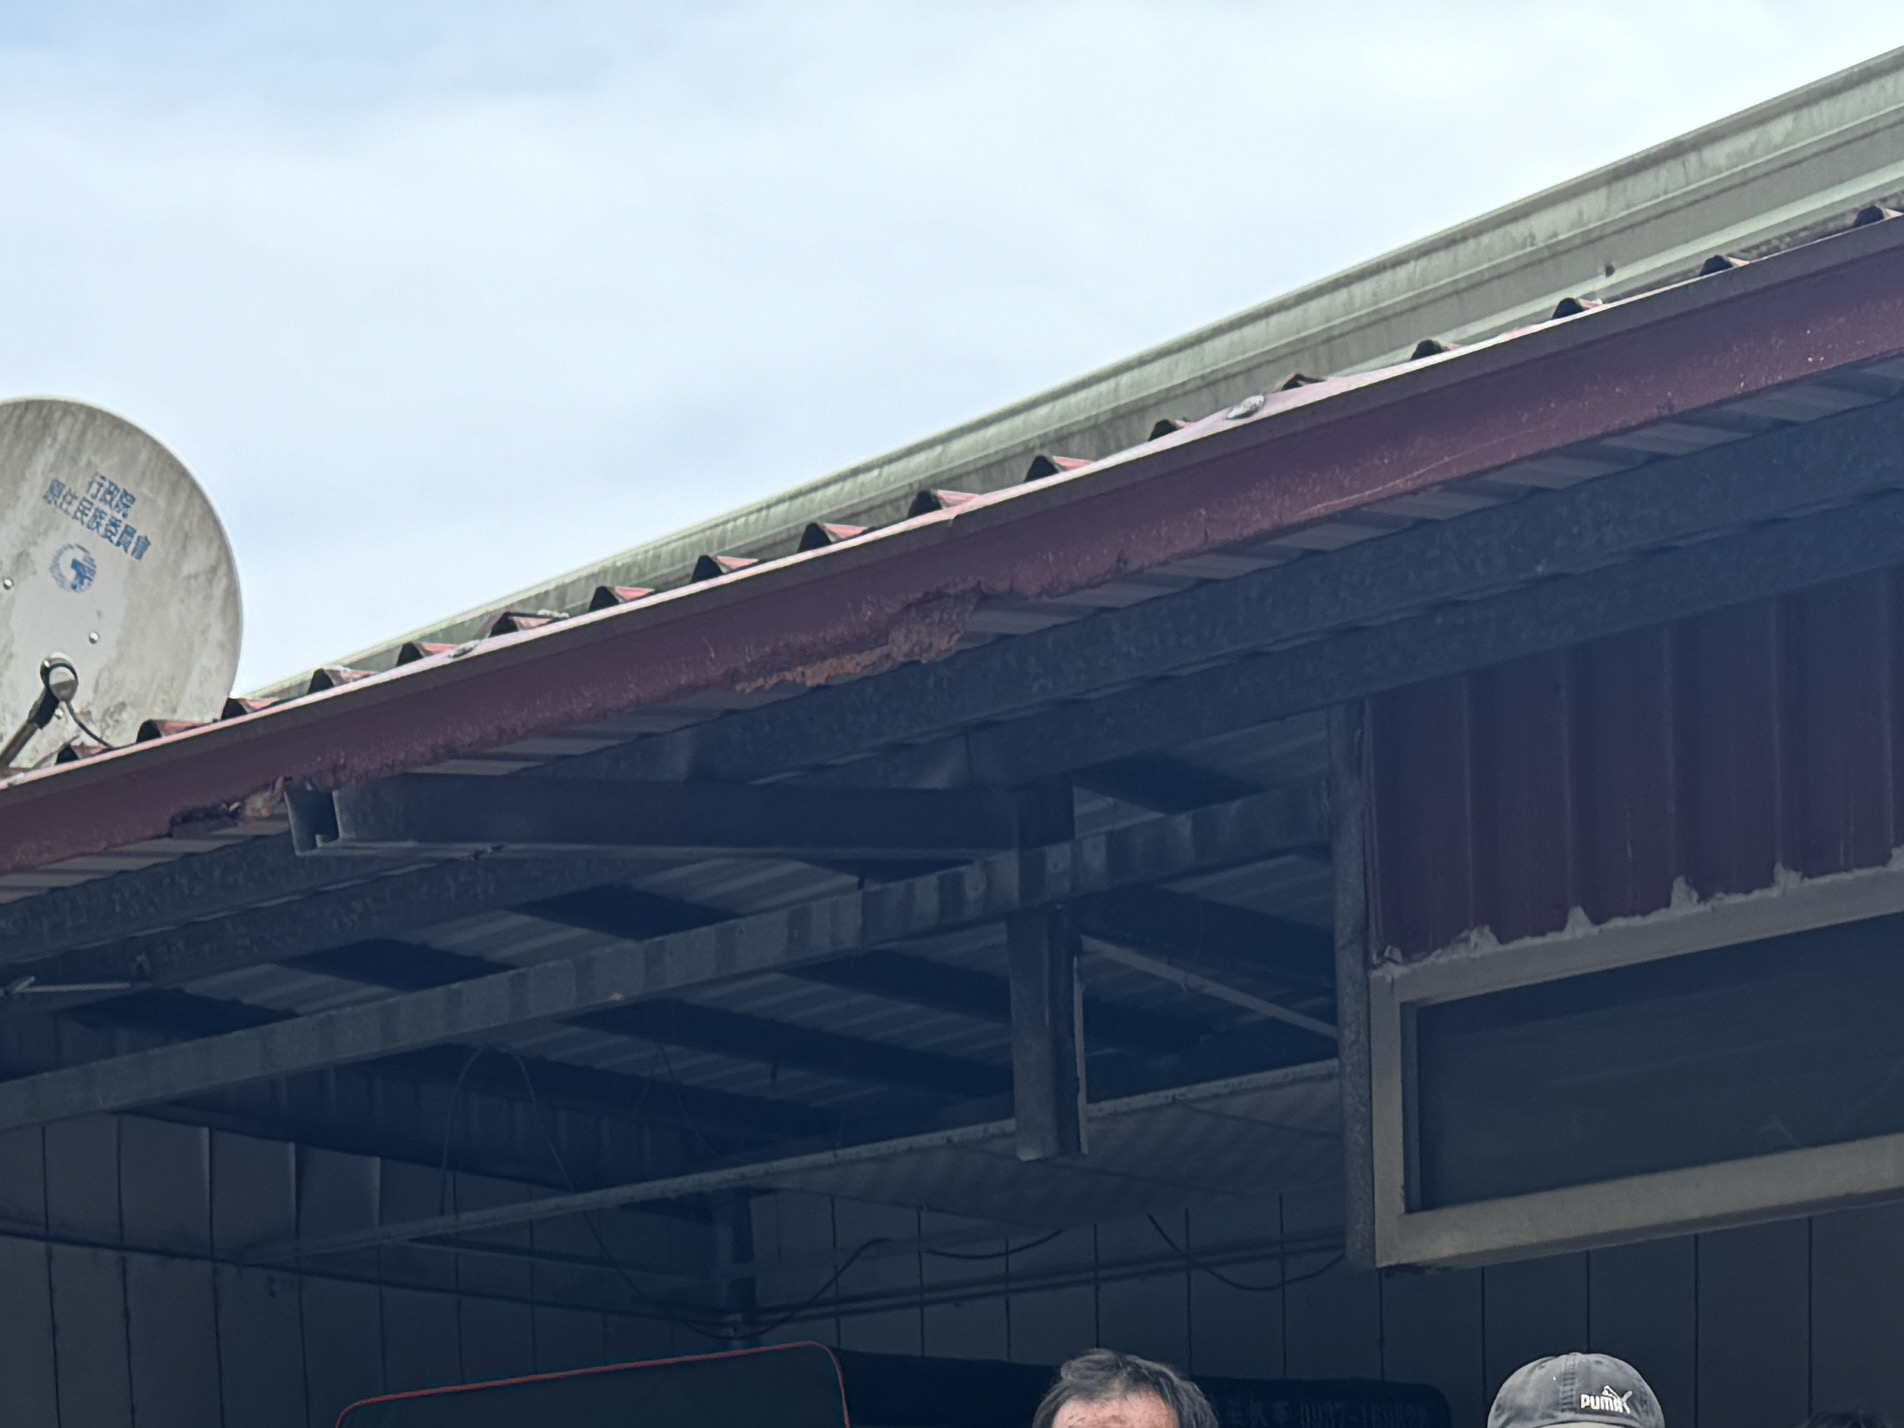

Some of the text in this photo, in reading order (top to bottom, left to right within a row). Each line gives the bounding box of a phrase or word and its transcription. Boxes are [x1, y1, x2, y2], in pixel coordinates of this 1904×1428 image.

[85, 473, 136, 519] 行政院
[42, 479, 151, 560] 原住民族委員會
[1580, 1393, 1624, 1414] PUMA
